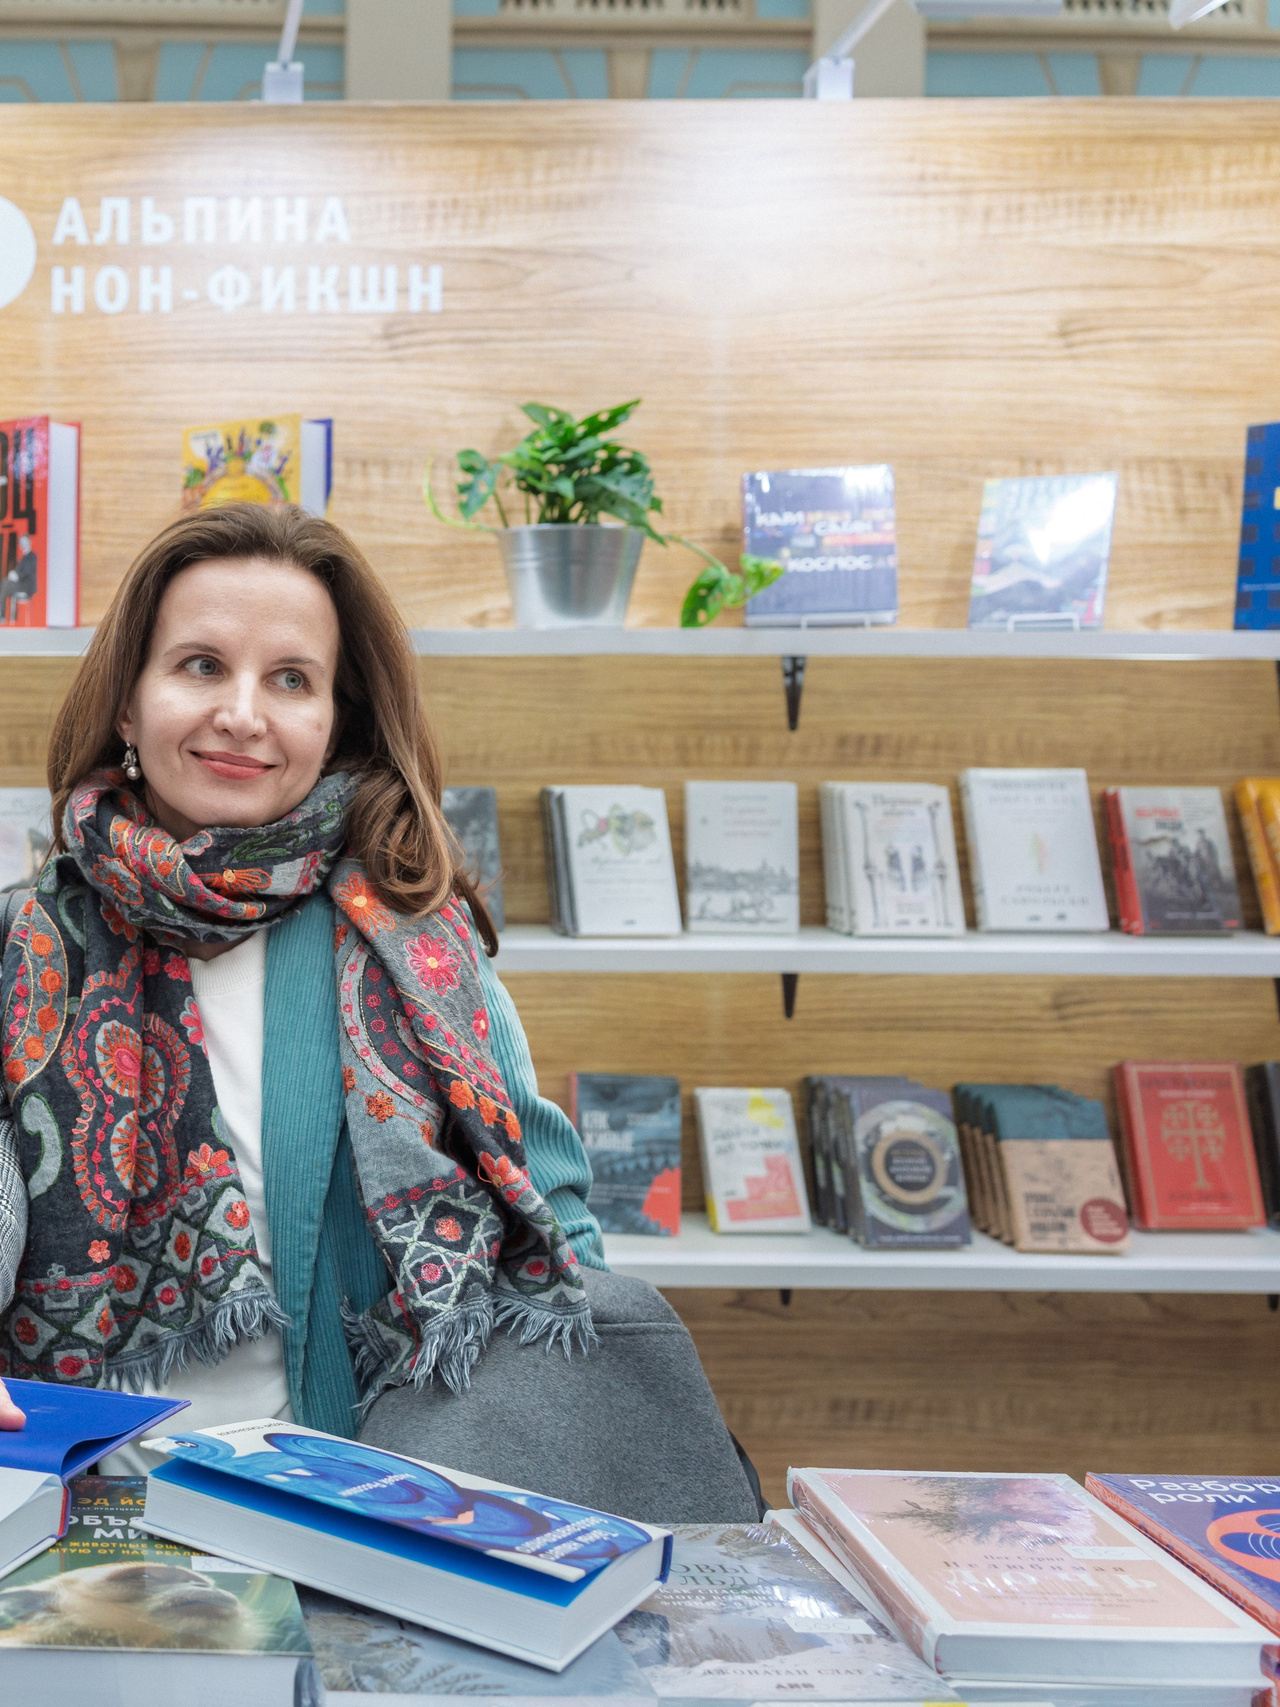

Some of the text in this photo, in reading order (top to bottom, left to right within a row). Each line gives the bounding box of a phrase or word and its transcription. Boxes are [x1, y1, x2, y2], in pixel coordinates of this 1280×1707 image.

[52, 197, 352, 245] АЛЬПИНА
[51, 264, 443, 315] НОН-ФИКШН
[77, 1497, 110, 1507] ЭД
[1148, 1492, 1257, 1504] роли
[69, 1541, 148, 1549] ЖИВОТНЫЕ
[942, 1560, 1126, 1573] Нелюбимая
[701, 1667, 809, 1677] ДЖОНАТАН
